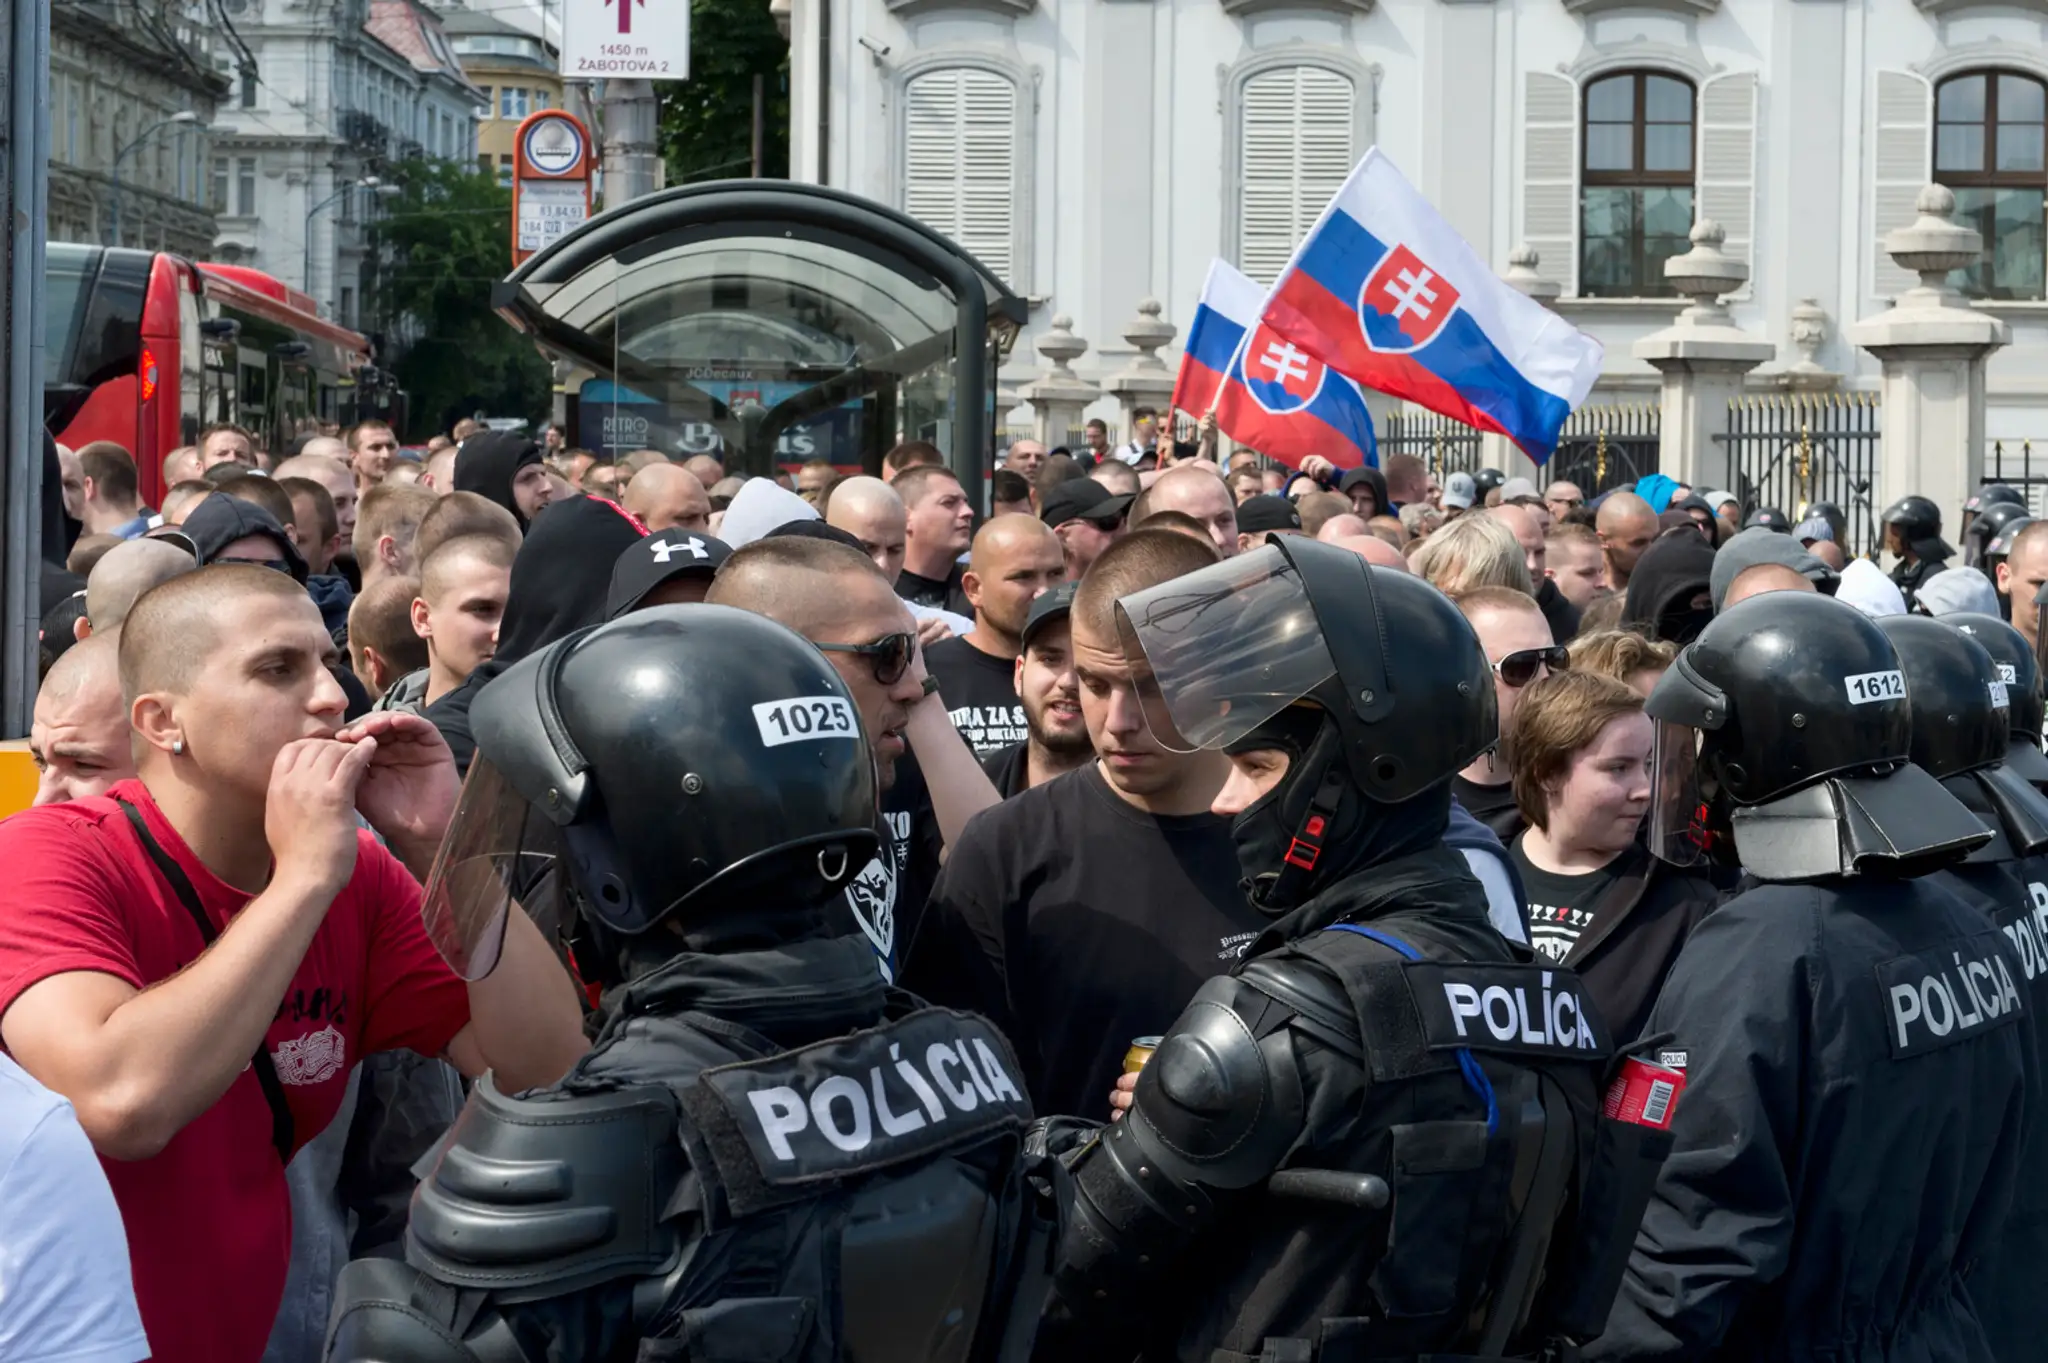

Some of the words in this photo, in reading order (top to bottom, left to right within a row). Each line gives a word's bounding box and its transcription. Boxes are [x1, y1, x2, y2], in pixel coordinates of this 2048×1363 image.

[600, 44, 632, 55] 1450
[635, 47, 648, 55] m
[578, 58, 656, 71] ŽABOTOVA
[661, 61, 669, 72] 2
[686, 367, 753, 380] JCDecaux
[1853, 674, 1903, 699] 1612
[768, 702, 850, 737] 1025
[1443, 971, 1597, 1049] POLÍCIA
[1890, 952, 2022, 1048] POLÍCIA
[748, 1037, 1022, 1161] POLÍCIA
